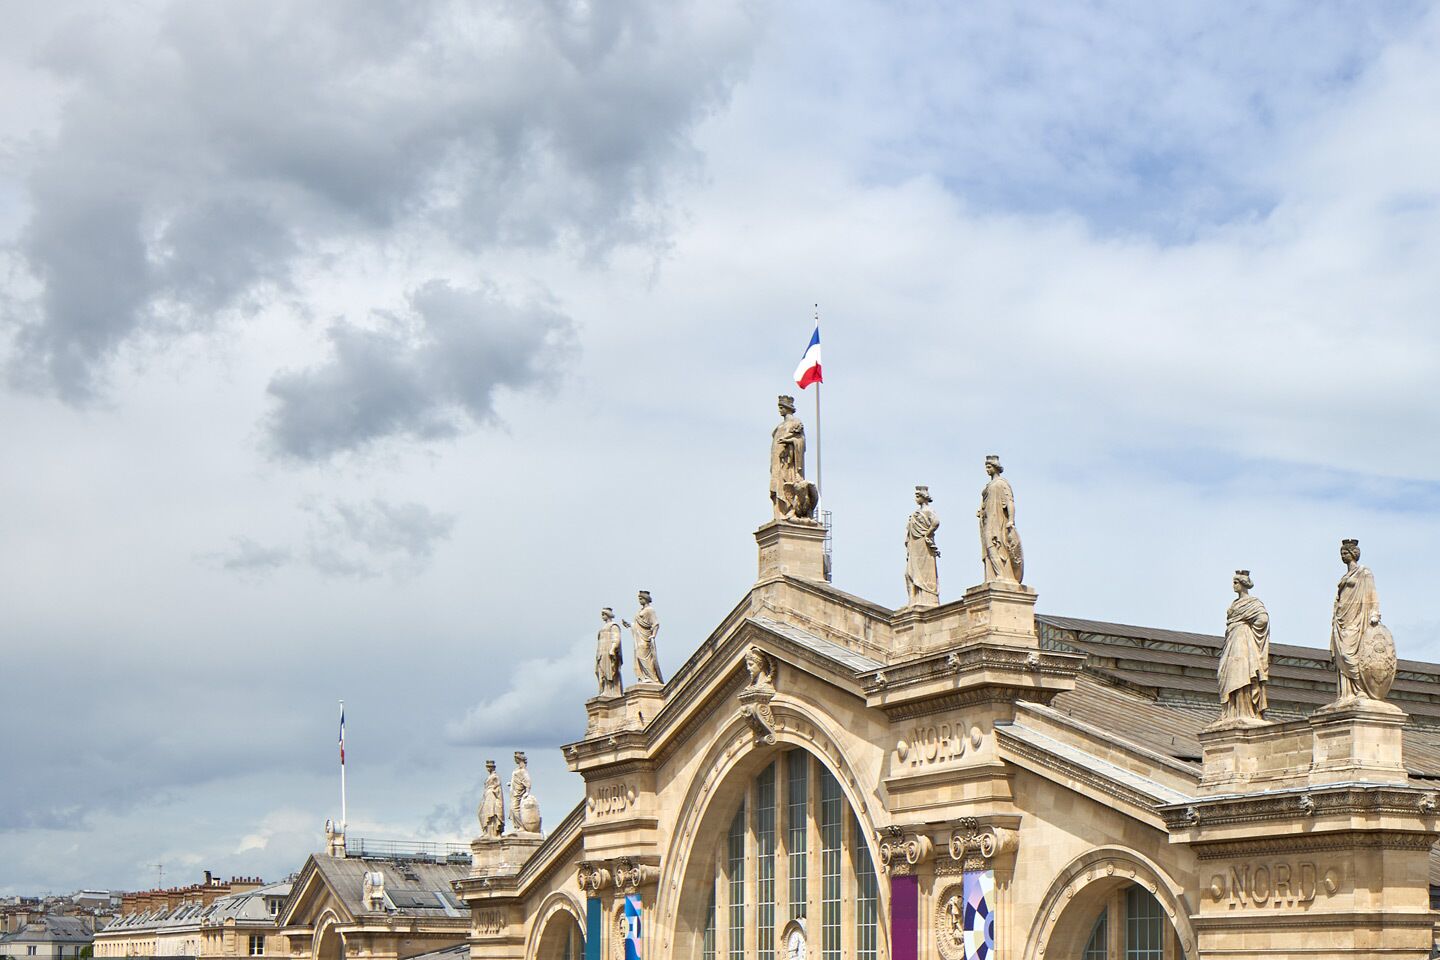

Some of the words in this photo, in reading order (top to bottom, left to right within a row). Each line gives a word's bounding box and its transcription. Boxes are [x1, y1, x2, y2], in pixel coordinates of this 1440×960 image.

[911, 722, 966, 763] NORD
[596, 784, 626, 813] NORD
[1229, 862, 1316, 905] NORD
